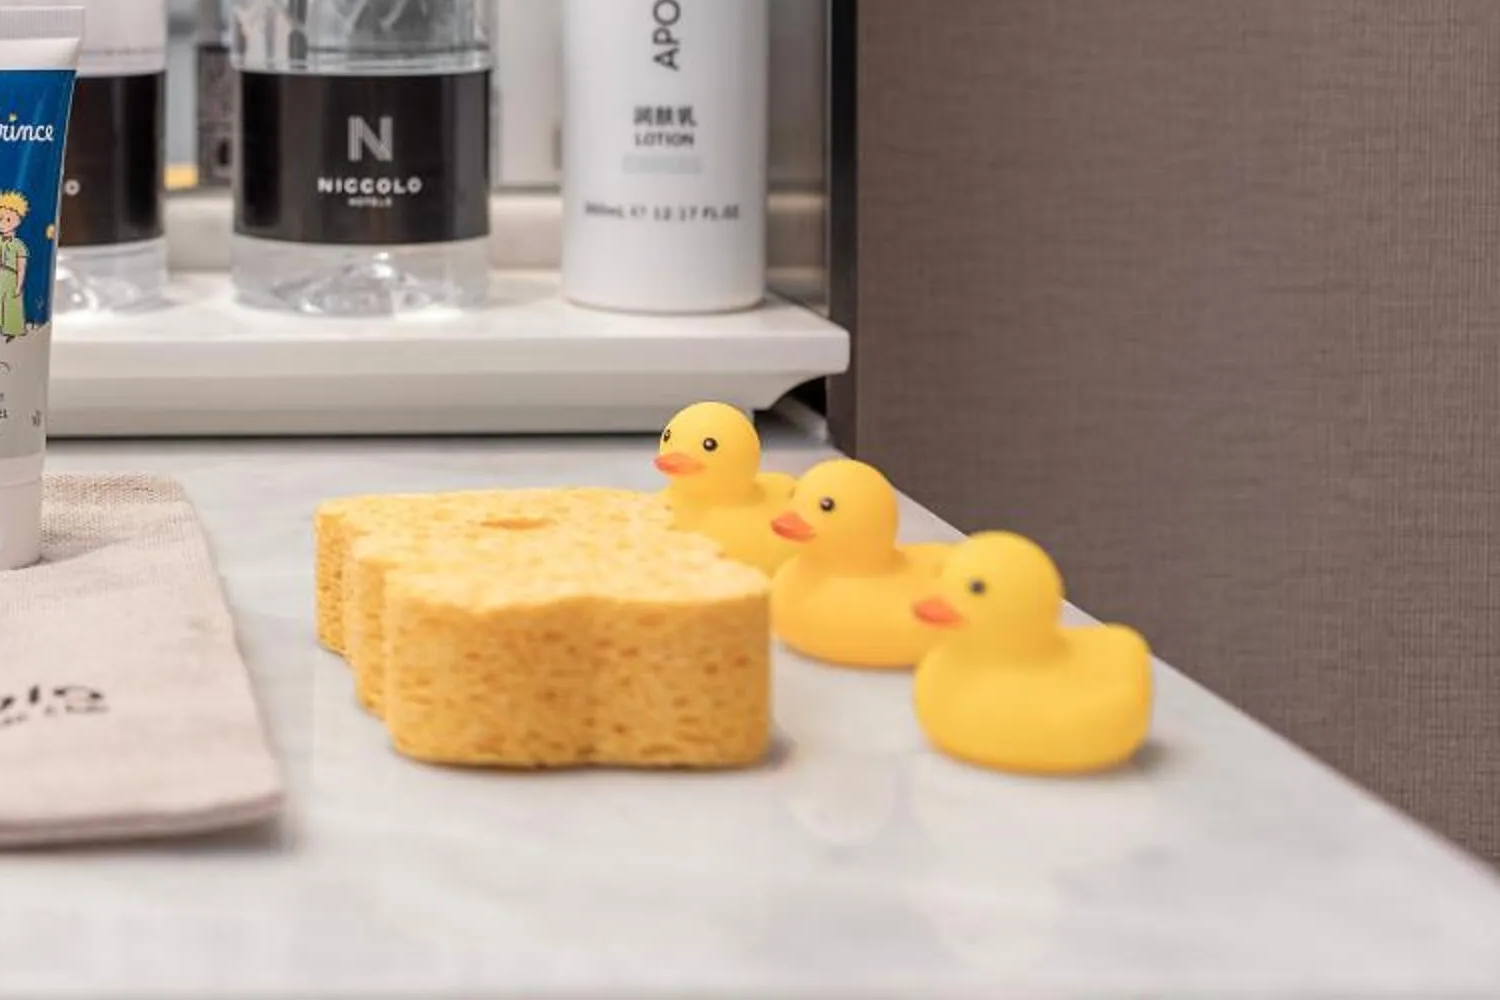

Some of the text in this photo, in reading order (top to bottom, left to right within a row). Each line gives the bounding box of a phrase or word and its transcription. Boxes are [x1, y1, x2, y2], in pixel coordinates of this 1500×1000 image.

[347, 115, 393, 162] N
[634, 132, 695, 147] LOTION
[317, 176, 423, 195] NICCOLO
